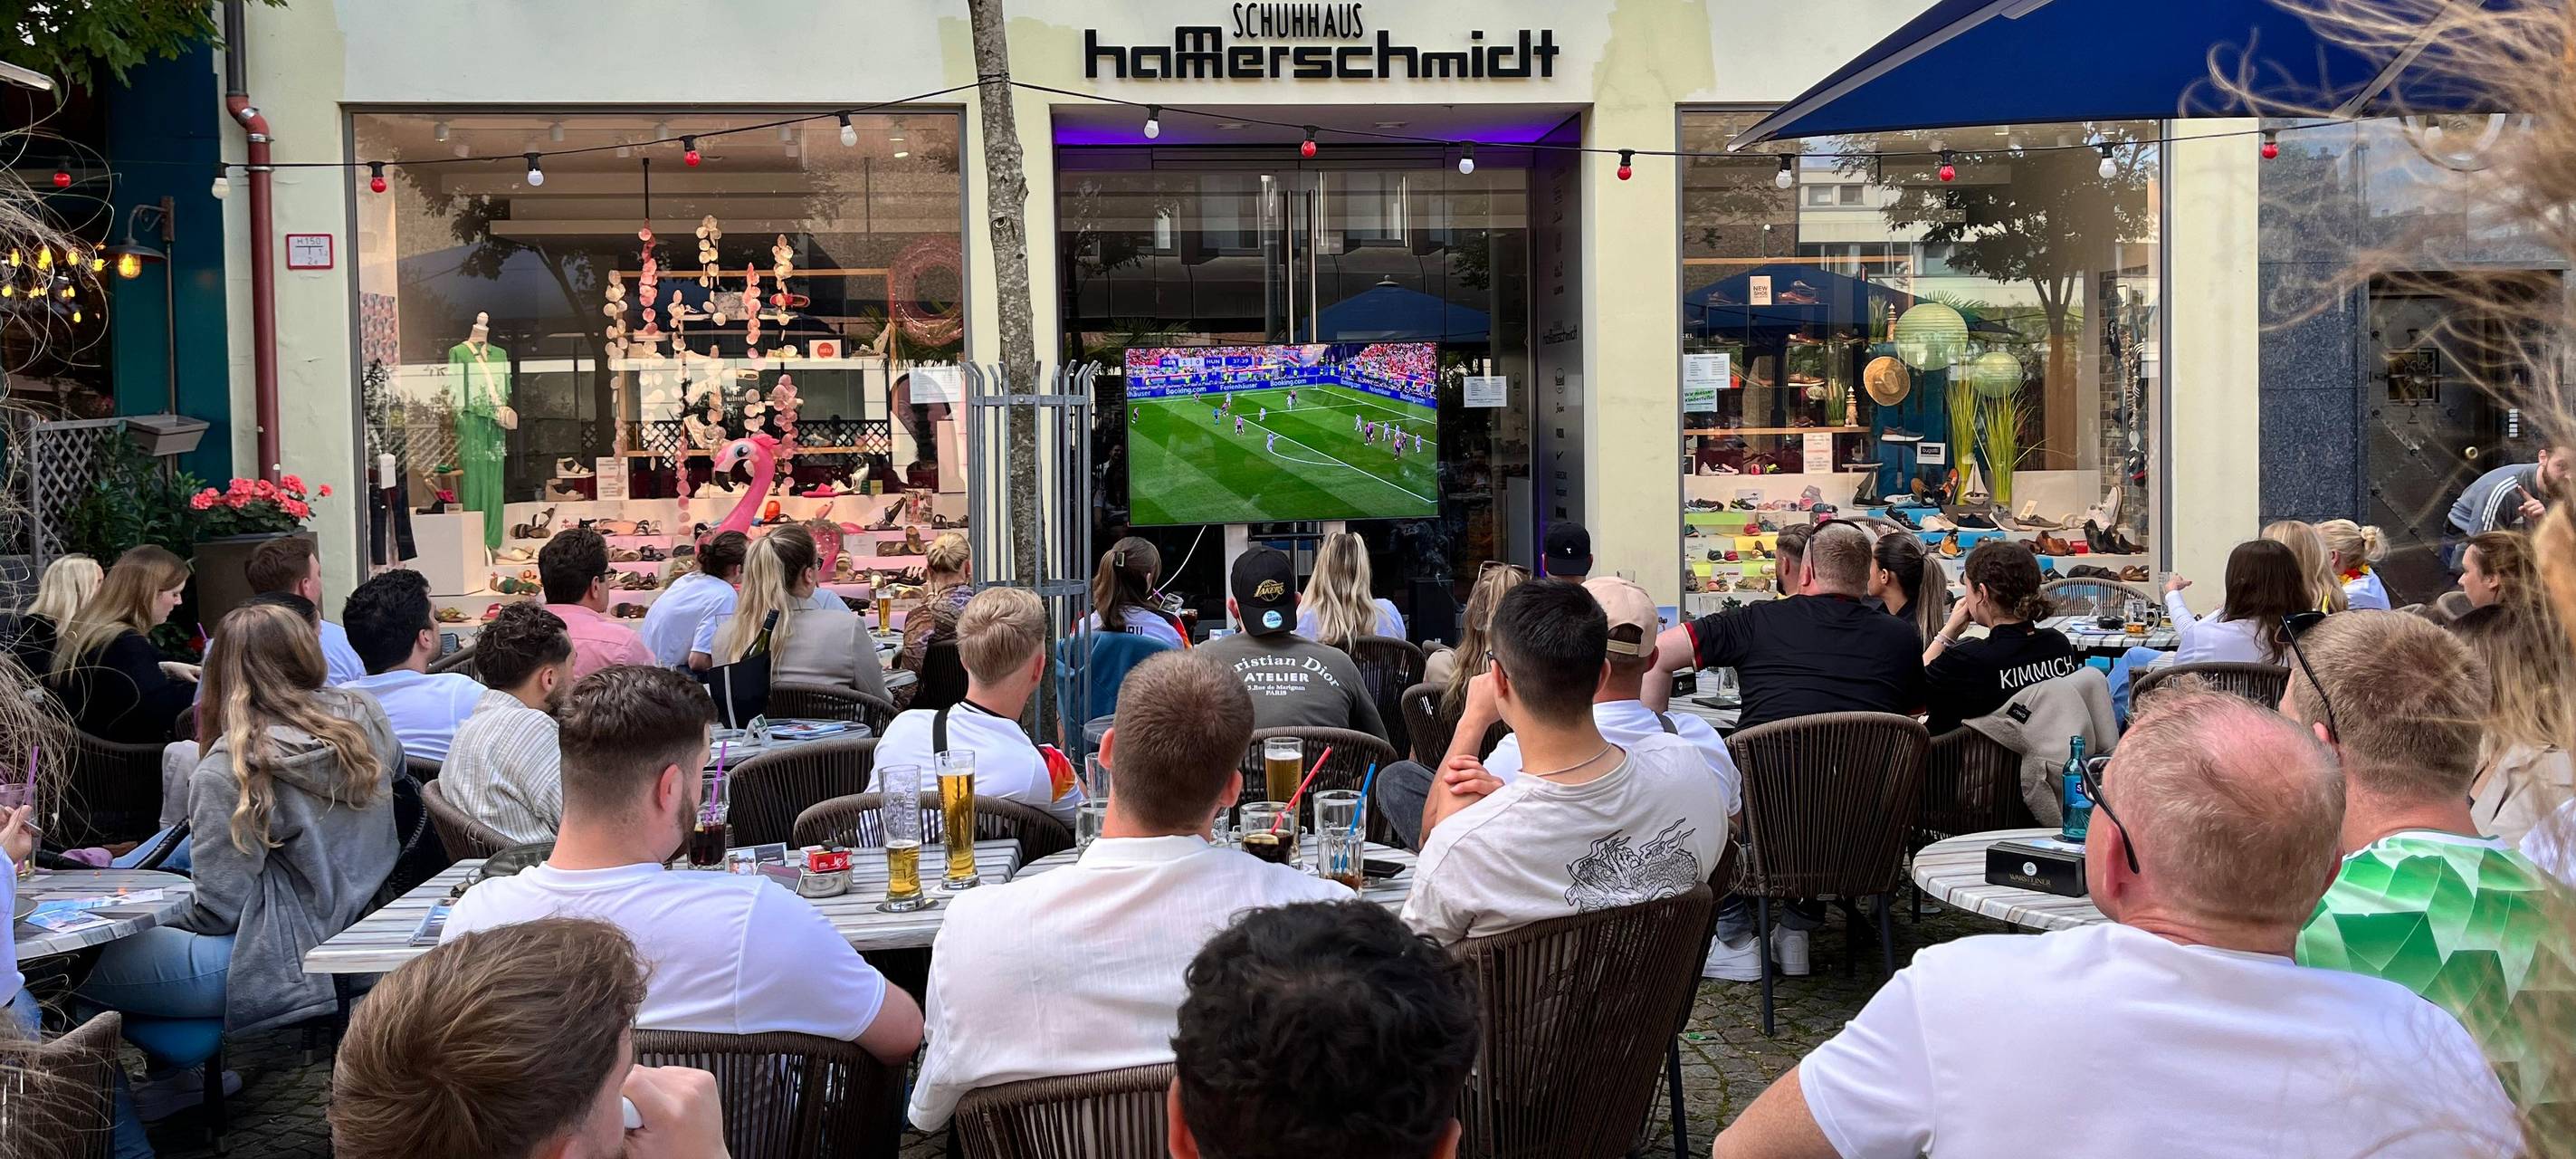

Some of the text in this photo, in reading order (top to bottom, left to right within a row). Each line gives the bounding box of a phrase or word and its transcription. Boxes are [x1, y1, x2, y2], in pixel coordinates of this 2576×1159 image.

[1232, 3, 1365, 39] SCHUHHAUS
[1165, 386, 1207, 396] Booking.com
[1219, 382, 1258, 391] Ferienhäuser
[1269, 378, 1307, 388] Booking.com
[1244, 672, 1310, 683] ATELIER
[1302, 656, 1340, 688] Dior
[1999, 655, 2075, 689] KIMMICH
[2012, 709, 2027, 719] ONLY
[2008, 873, 2052, 886] WARSTEINER
